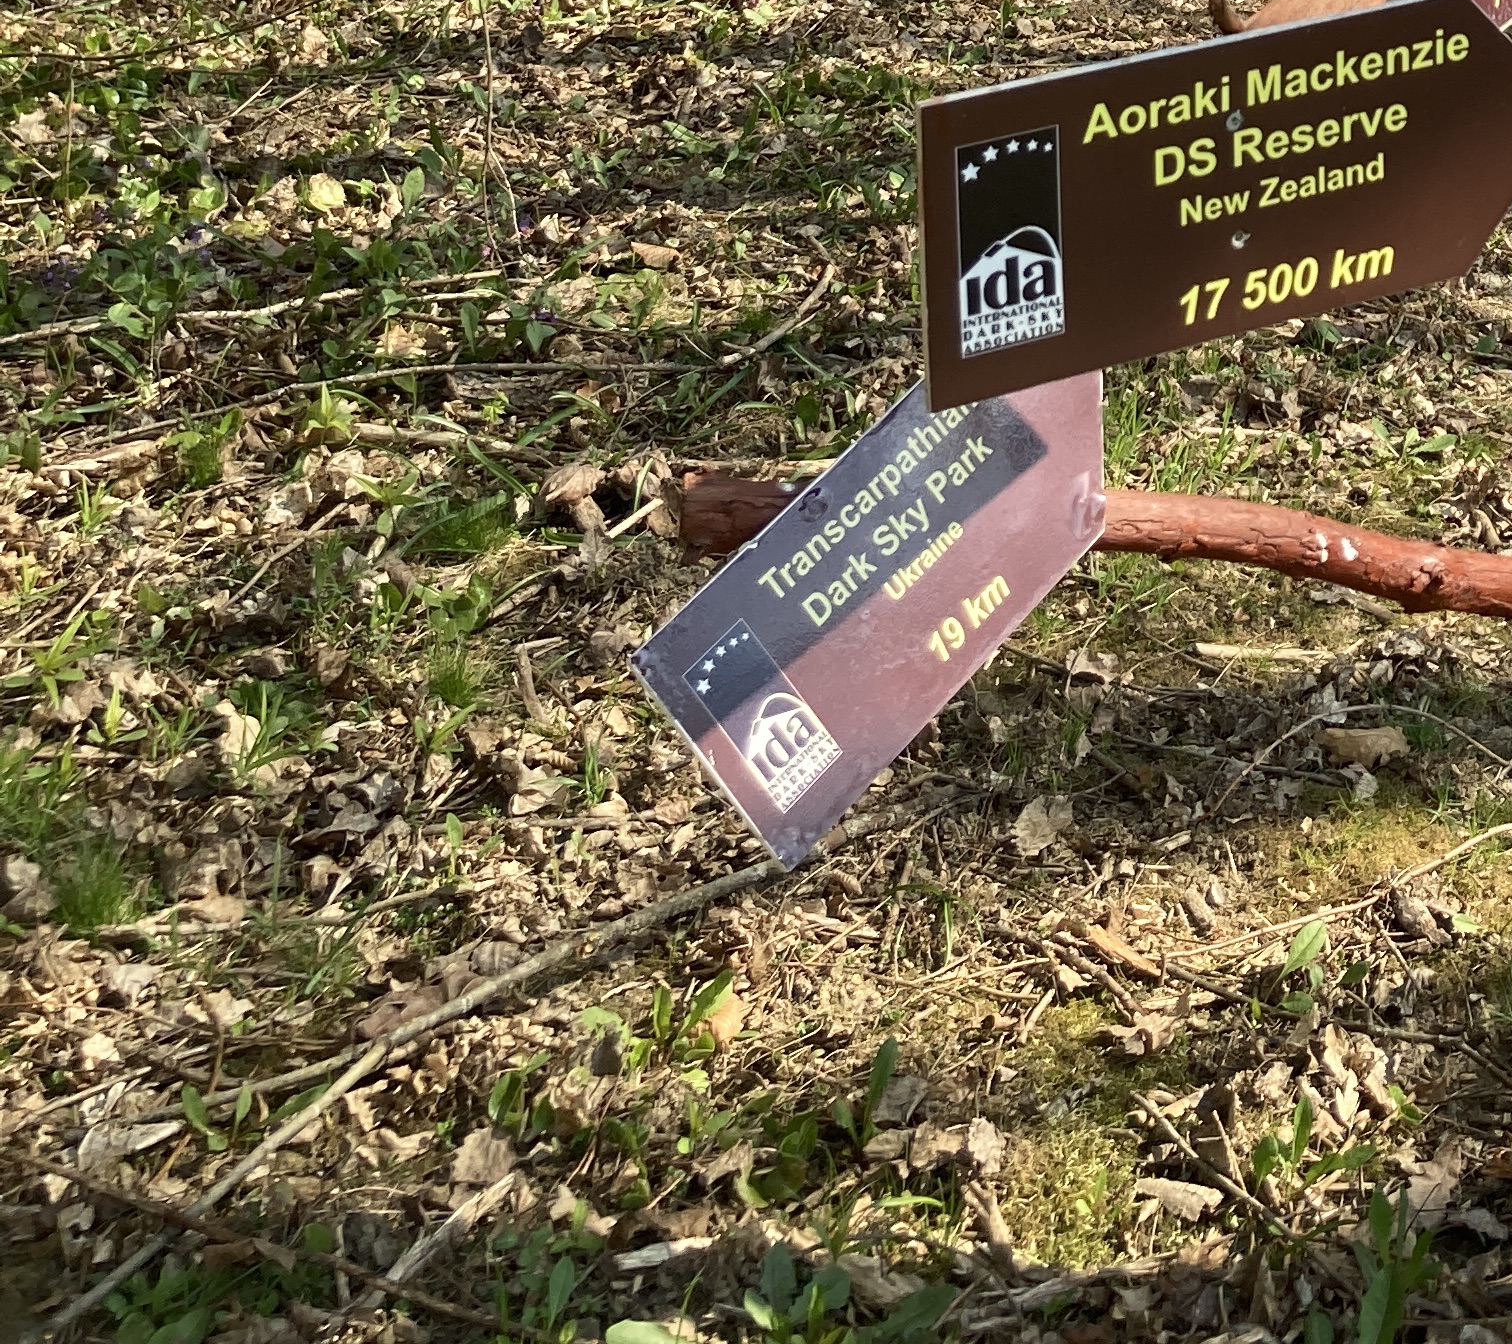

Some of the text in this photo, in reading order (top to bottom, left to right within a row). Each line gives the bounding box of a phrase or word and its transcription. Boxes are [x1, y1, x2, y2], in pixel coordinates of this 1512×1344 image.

[1082, 29, 1470, 145] Aoraki Mackenzie
[1154, 102, 1409, 187] DS Reserve
[1178, 153, 1386, 227] New Zealand
[963, 297, 1063, 329] INTERNATIONAL
[1179, 244, 1395, 327] 17 500 km
[965, 323, 1063, 355] ASSOCIATION
[800, 433, 994, 628] Dark Sky Park
[882, 520, 964, 603] Ukraine
[927, 573, 1012, 664] 19 km
[767, 731, 828, 793] INTERNATIONAL
